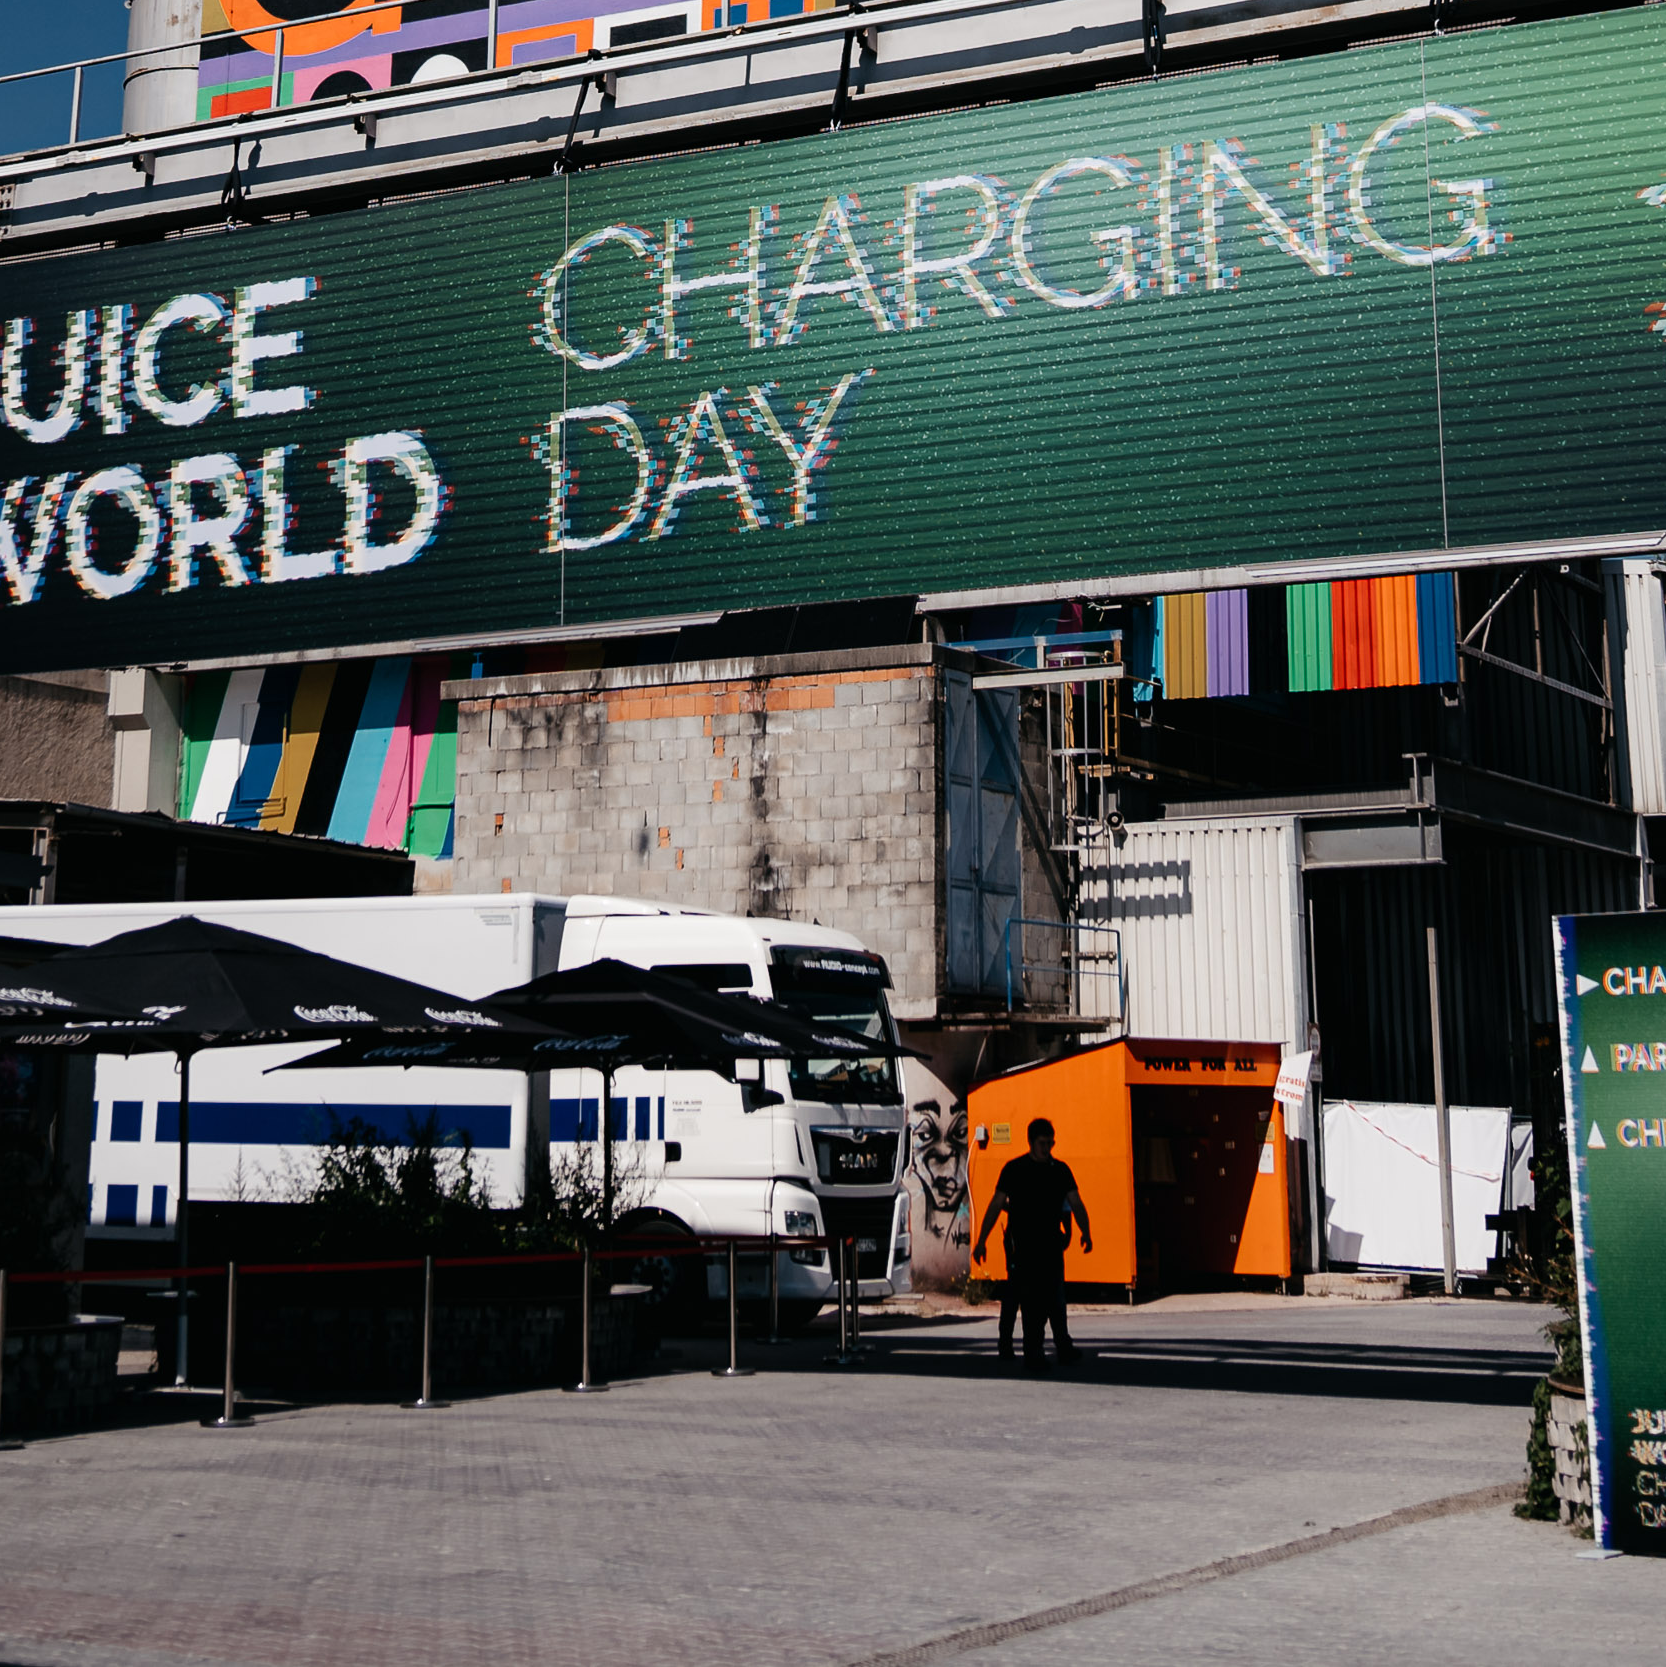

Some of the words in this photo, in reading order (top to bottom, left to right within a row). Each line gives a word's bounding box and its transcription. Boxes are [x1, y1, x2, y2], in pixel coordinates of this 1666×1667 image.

[531, 101, 1513, 372] CHARGING
[520, 368, 876, 554] DAY
[1144, 1057, 1191, 1072] POWER
[1200, 1057, 1226, 1072] FOR
[1234, 1057, 1258, 1072] ALL
[838, 1151, 878, 1170] MAN
